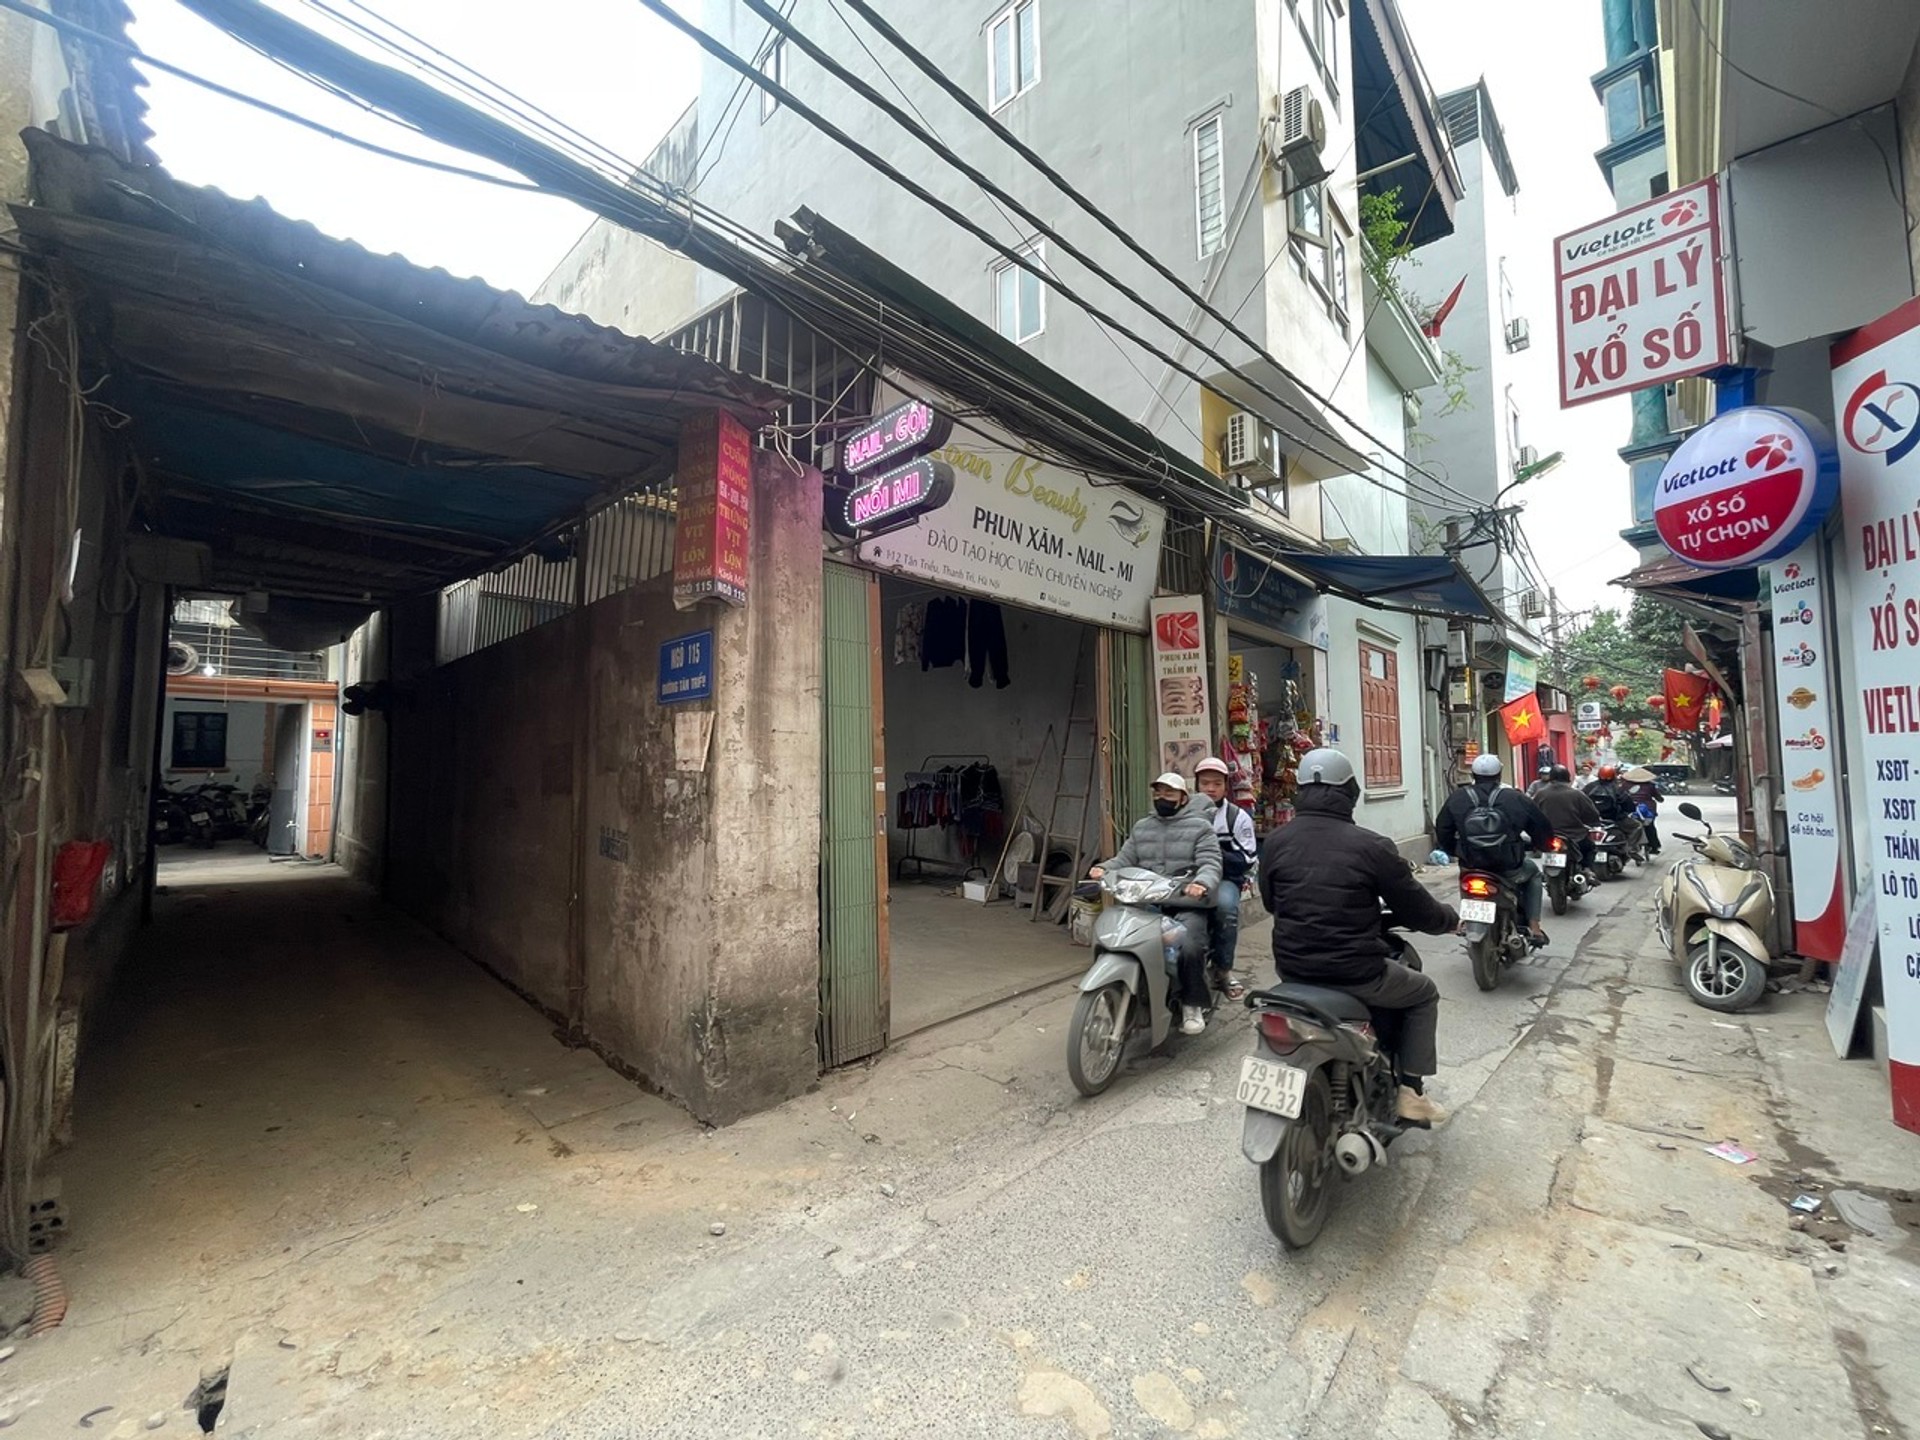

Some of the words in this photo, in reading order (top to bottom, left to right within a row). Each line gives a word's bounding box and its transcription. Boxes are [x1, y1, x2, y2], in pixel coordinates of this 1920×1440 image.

[1566, 217, 1656, 260] Vietlott
[1570, 267, 1639, 324] ĐẠI
[1654, 237, 1703, 297] LÝ
[1573, 322, 1628, 390] XỔ
[1643, 301, 1702, 370] SỐ
[848, 430, 884, 467] NAIL
[893, 471, 920, 506] MI
[1663, 456, 1738, 493] Vietlott
[1686, 500, 1712, 525] XỔ
[1716, 491, 1746, 517] SỐ
[972, 505, 1023, 545] PHUN
[1026, 526, 1064, 559] XĂM
[1076, 545, 1106, 574] NAIL
[1117, 560, 1134, 583] MI
[1678, 529, 1702, 552] TỰ
[1706, 515, 1770, 544] CHỌN
[1862, 518, 1897, 578] ĐẠI
[927, 529, 959, 553] ĐÀO
[962, 540, 987, 562] TẠO
[989, 549, 1016, 571] HỌC
[1046, 567, 1087, 591] CHUYÊN
[1088, 580, 1123, 603] NGHIỆP
[694, 580, 713, 593] 115
[733, 586, 746, 601] 115
[1774, 577, 1816, 594] Vietlott
[1870, 583, 1899, 651] XỔ
[1904, 598, 1920, 646] S
[688, 641, 701, 665] 115
[1863, 684, 1920, 734] VIETL
[1876, 760, 1909, 782] XSĐT
[1883, 798, 1916, 821] XSĐT
[1882, 870, 1898, 897] LÔ
[1901, 872, 1918, 900] TÔ
[1240, 1080, 1297, 1114] 072.32
